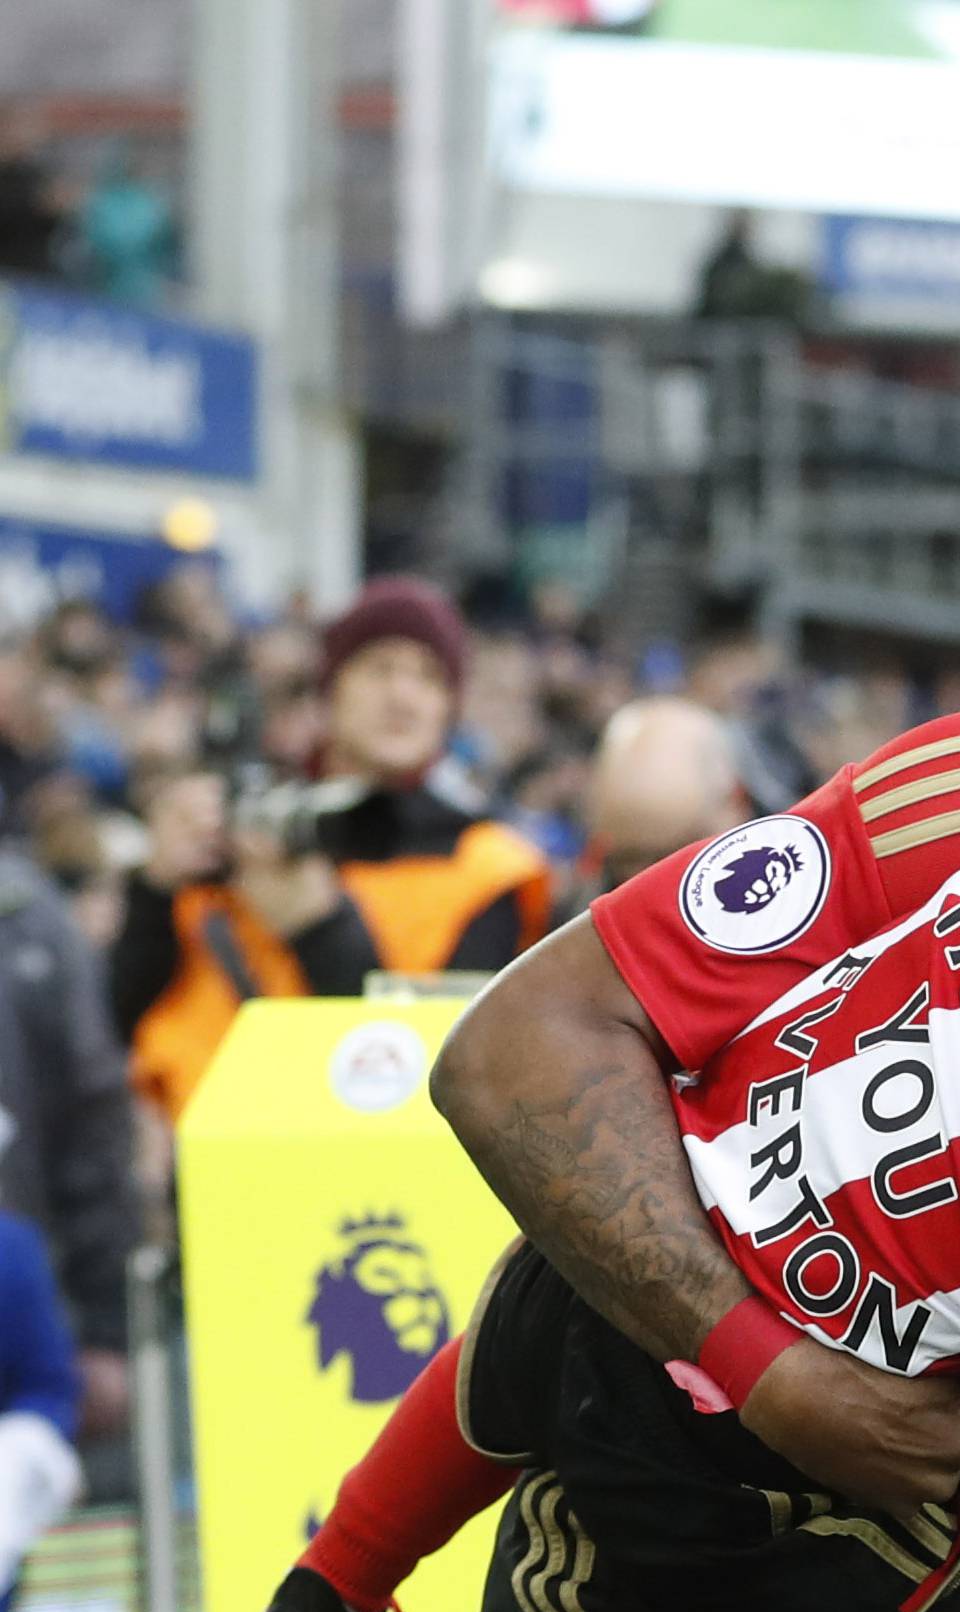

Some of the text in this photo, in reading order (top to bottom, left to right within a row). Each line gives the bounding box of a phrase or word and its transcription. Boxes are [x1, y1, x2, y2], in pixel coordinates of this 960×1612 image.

[691, 833, 749, 908] Premier League
[747, 949, 934, 1377] EVERTON
[856, 984, 958, 1219] YOU
